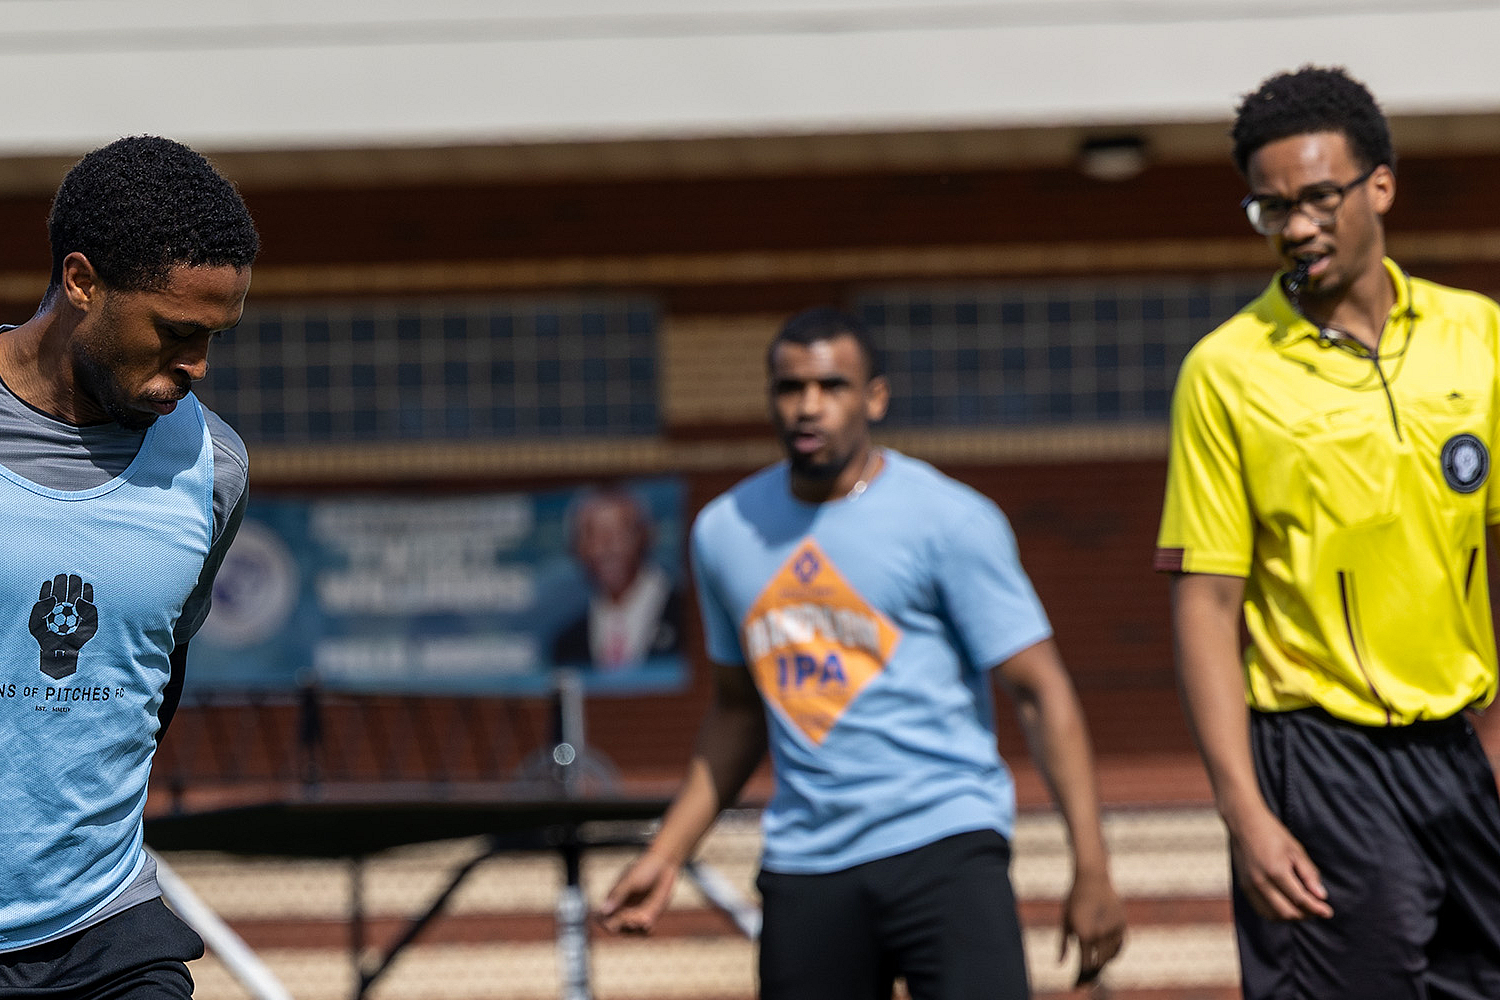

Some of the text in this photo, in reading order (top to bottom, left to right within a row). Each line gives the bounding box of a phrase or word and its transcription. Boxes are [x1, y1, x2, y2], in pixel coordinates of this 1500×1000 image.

[778, 654, 846, 688] IPA
[23, 686, 39, 698] OF
[45, 686, 111, 702] PITCHES
[114, 687, 125, 699] FC
